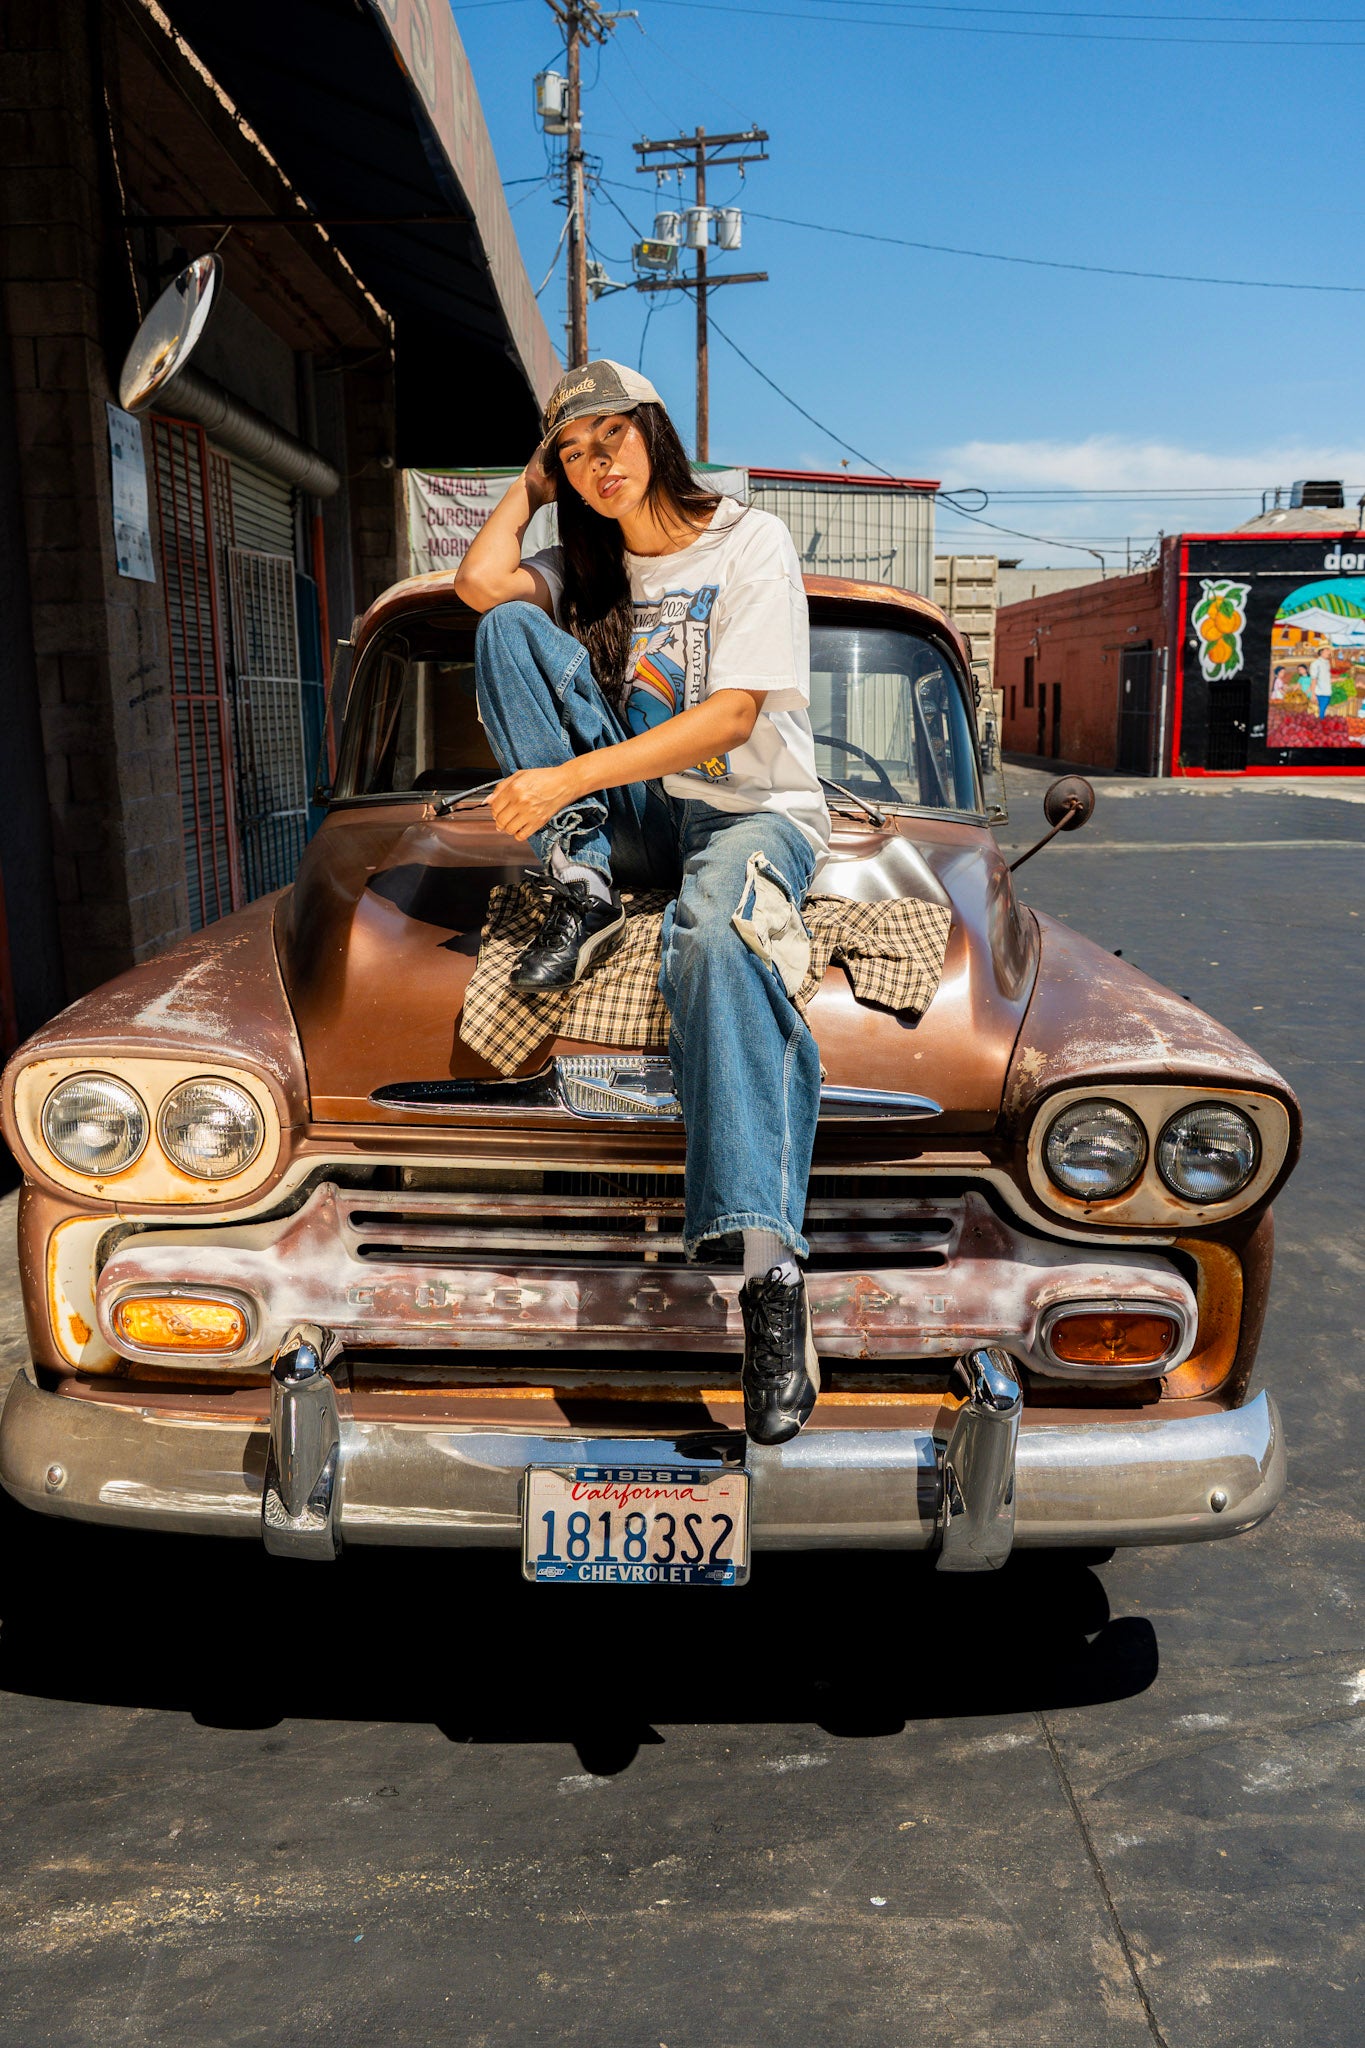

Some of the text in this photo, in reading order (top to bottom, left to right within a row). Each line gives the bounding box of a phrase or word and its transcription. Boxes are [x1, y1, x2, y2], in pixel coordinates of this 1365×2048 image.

[690, 626, 704, 695] PRAYER
[347, 1286, 954, 1314] CHEVROET
[604, 1469, 672, 1482] 1958
[571, 1483, 709, 1509] California
[537, 1510, 733, 1564] 18183S2
[578, 1564, 693, 1582] CHEVROLET
